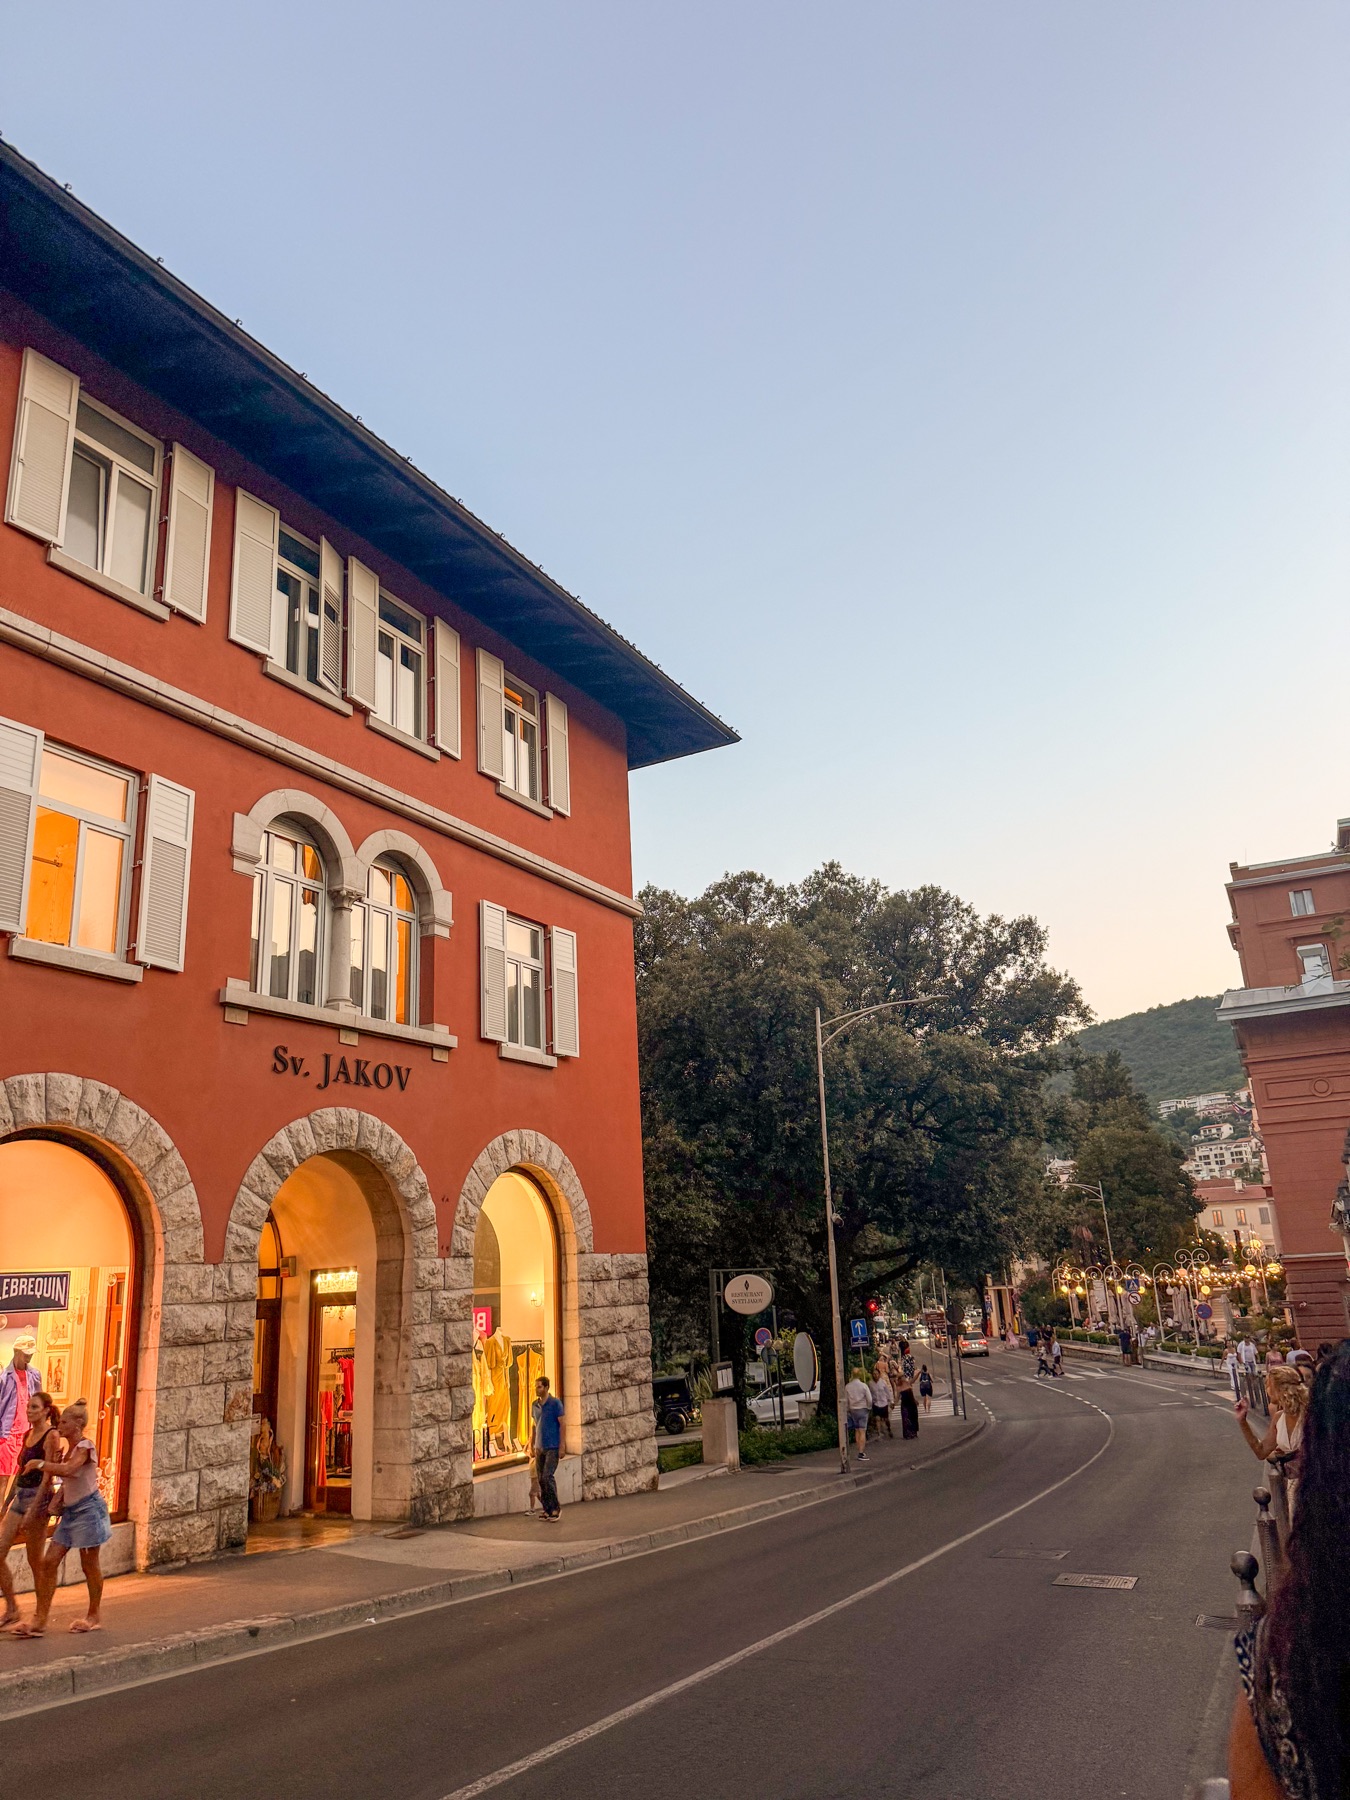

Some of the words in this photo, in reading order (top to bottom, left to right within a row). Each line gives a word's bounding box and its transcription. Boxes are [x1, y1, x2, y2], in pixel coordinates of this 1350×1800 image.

[272, 1045, 310, 1077] Sv.
[317, 1053, 412, 1091] JAKOV
[0, 1276, 67, 1306] EBREQUIN
